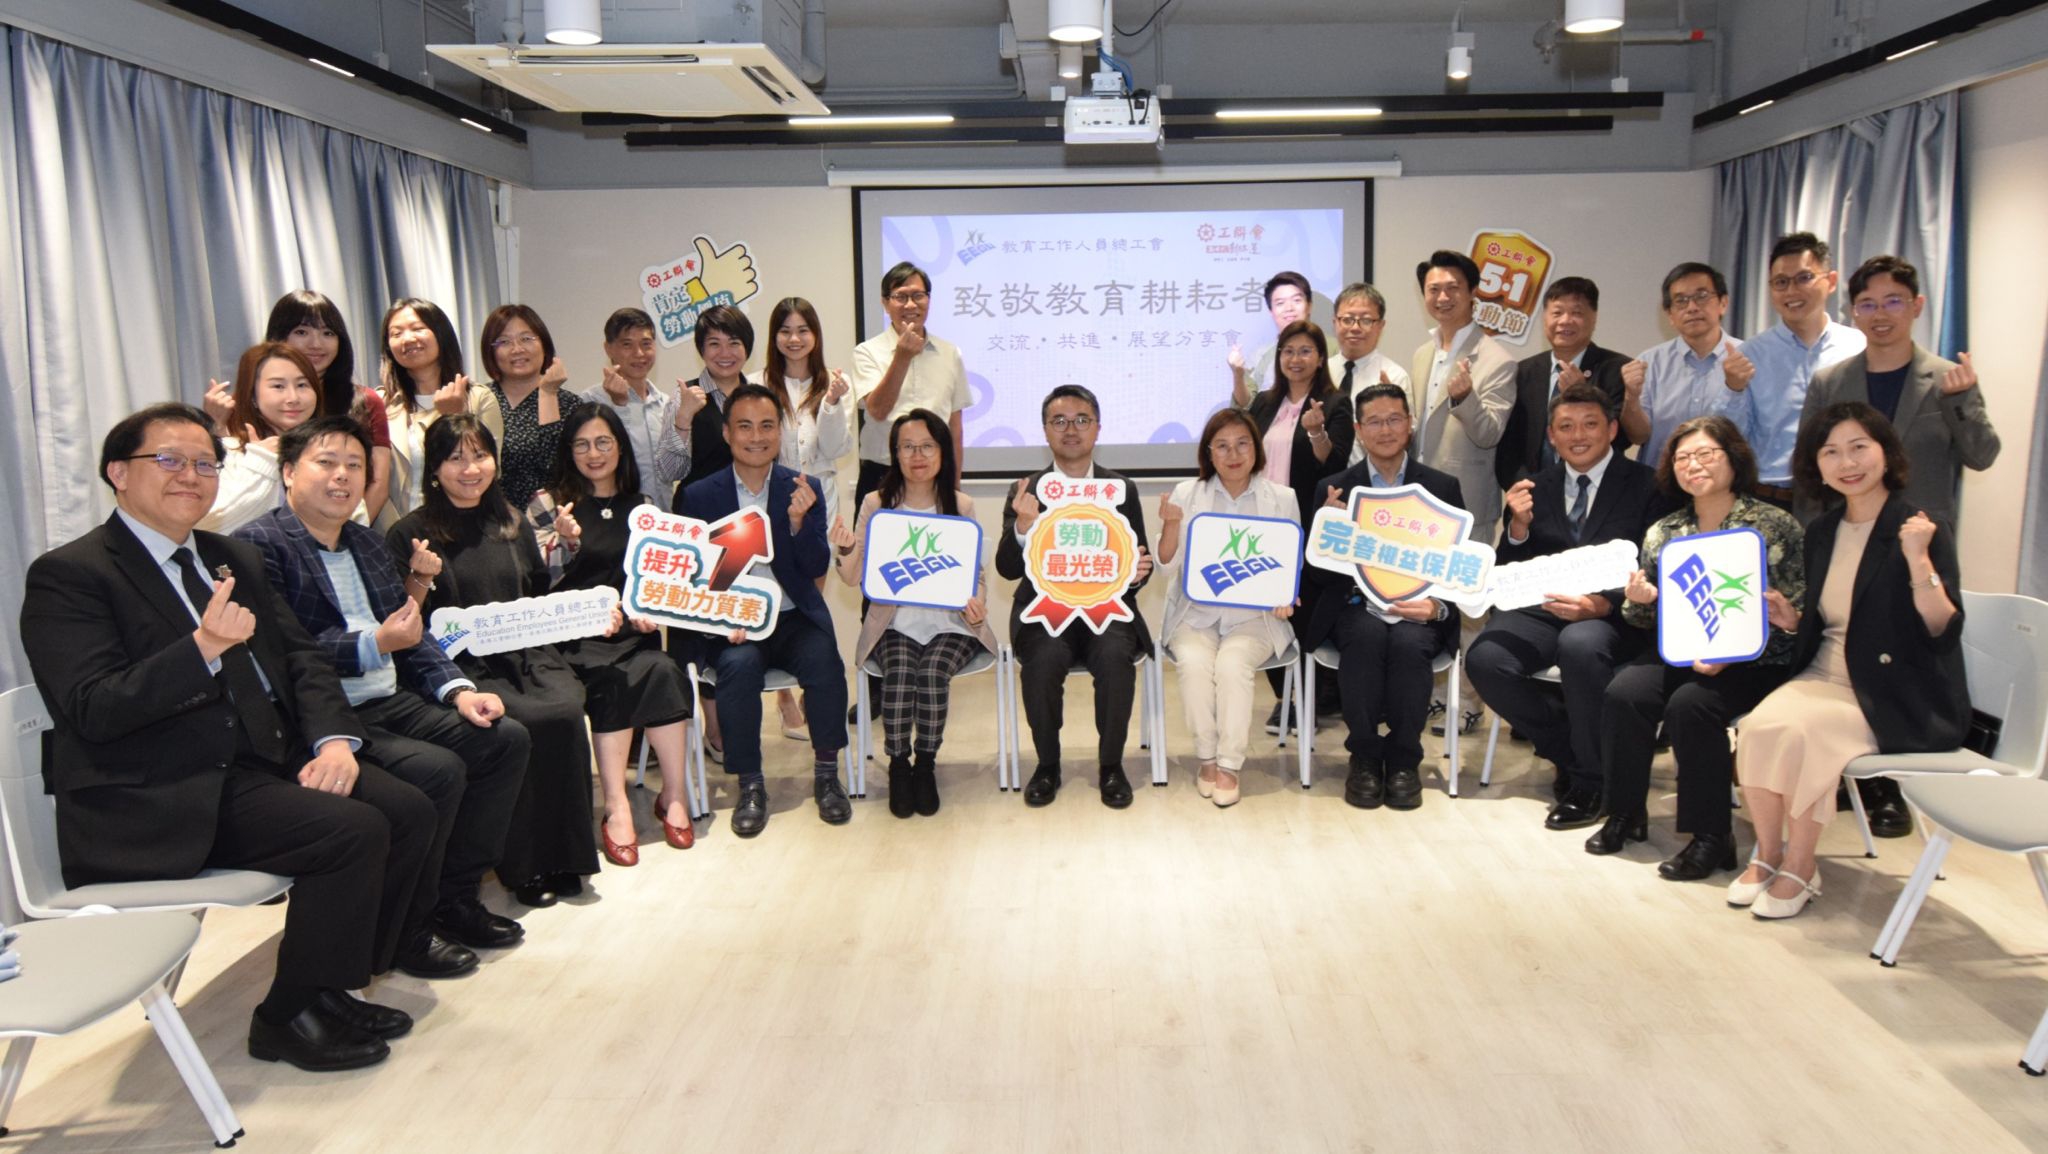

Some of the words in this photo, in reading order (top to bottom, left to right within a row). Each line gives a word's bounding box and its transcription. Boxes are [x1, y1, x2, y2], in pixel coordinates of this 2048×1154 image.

[1002, 237, 1164, 253] 教育工作人員總工會
[652, 285, 690, 314] 肯定
[953, 277, 1267, 318] 致敬教育耕耘者
[1473, 298, 1525, 333] 動節
[1067, 483, 1119, 500] 工聯會
[657, 520, 704, 540] 工聯會
[1059, 523, 1103, 547] 勞動
[1393, 517, 1440, 537] 工聯會
[642, 547, 692, 578] 提升
[1047, 553, 1113, 577] 最光榮
[1319, 520, 1483, 587] 完善權益保障
[879, 555, 962, 595] EEGU
[1200, 556, 1284, 597] EEGU
[474, 597, 610, 628] 教育工作人員總工會
[642, 579, 762, 622] 勞動力質素
[1668, 553, 1720, 643] EEGU
[437, 629, 470, 651] EEGU
[476, 625, 516, 638] Education
[517, 619, 557, 633] Employees
[559, 613, 586, 624] General
